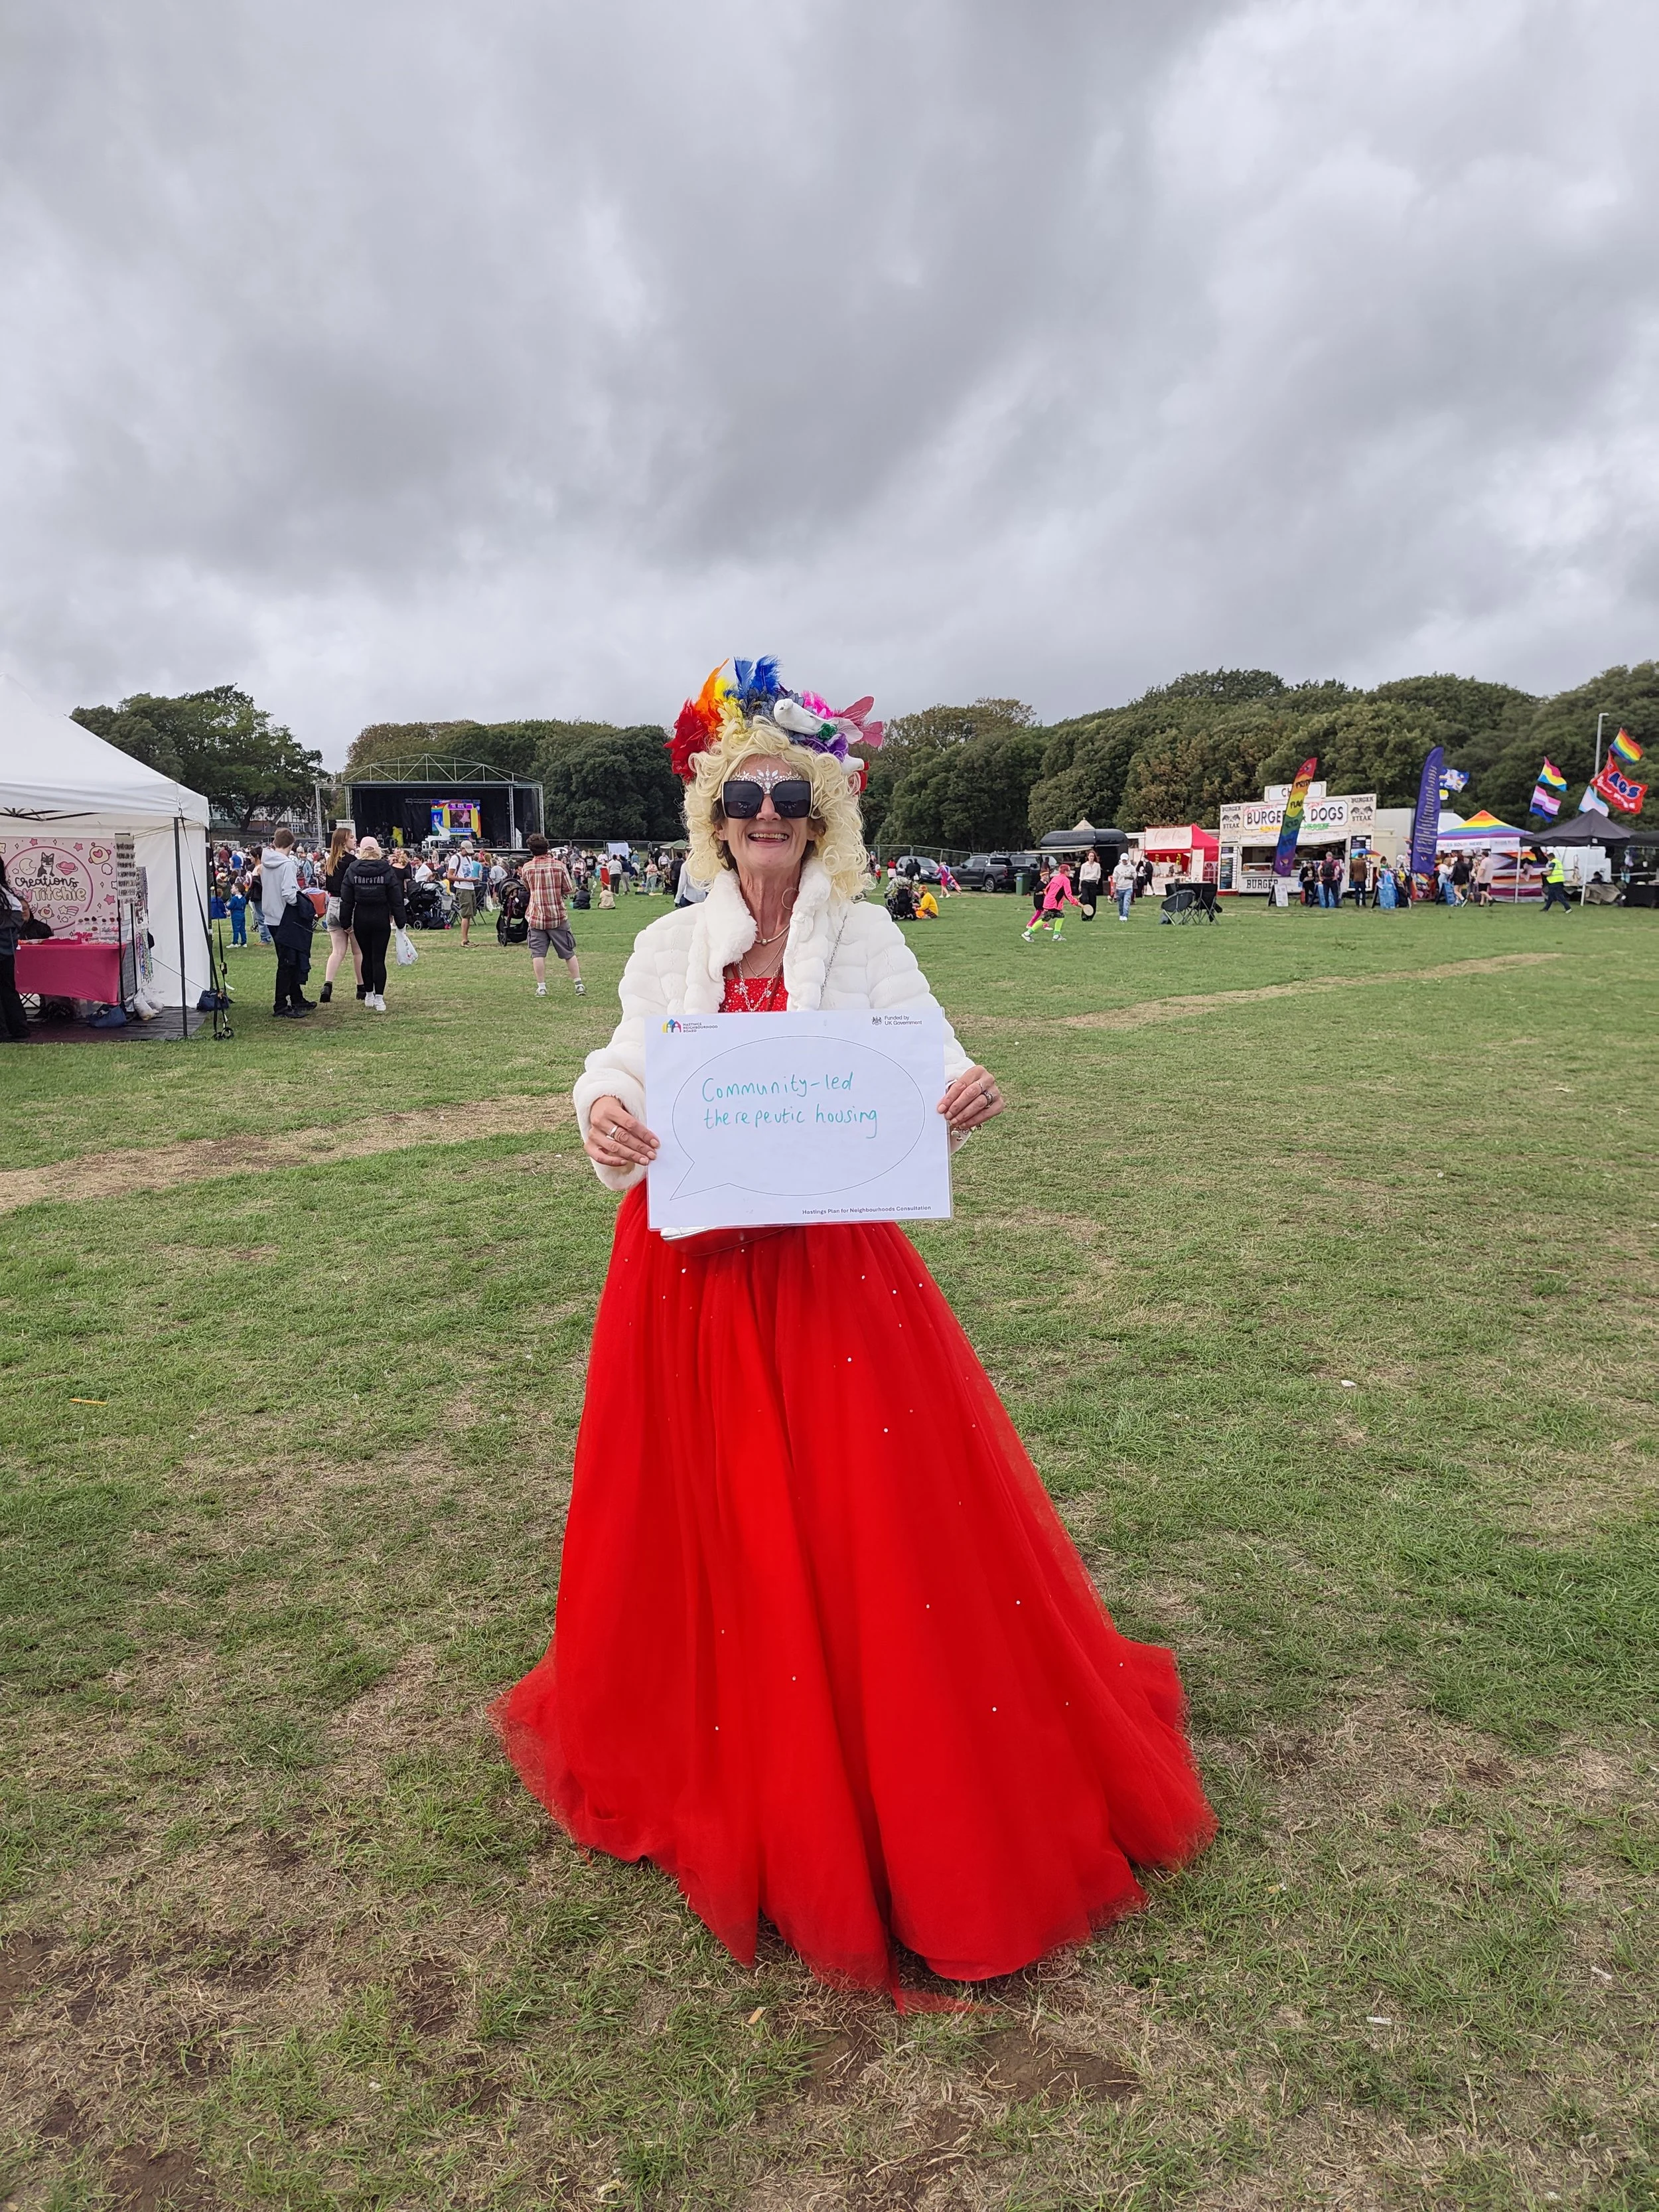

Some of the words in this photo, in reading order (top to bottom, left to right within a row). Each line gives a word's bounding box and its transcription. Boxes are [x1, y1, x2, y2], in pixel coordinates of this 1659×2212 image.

[1311, 806, 1344, 822] DOGS
[702, 1071, 853, 1102] Community-led
[816, 1103, 877, 1139] housing
